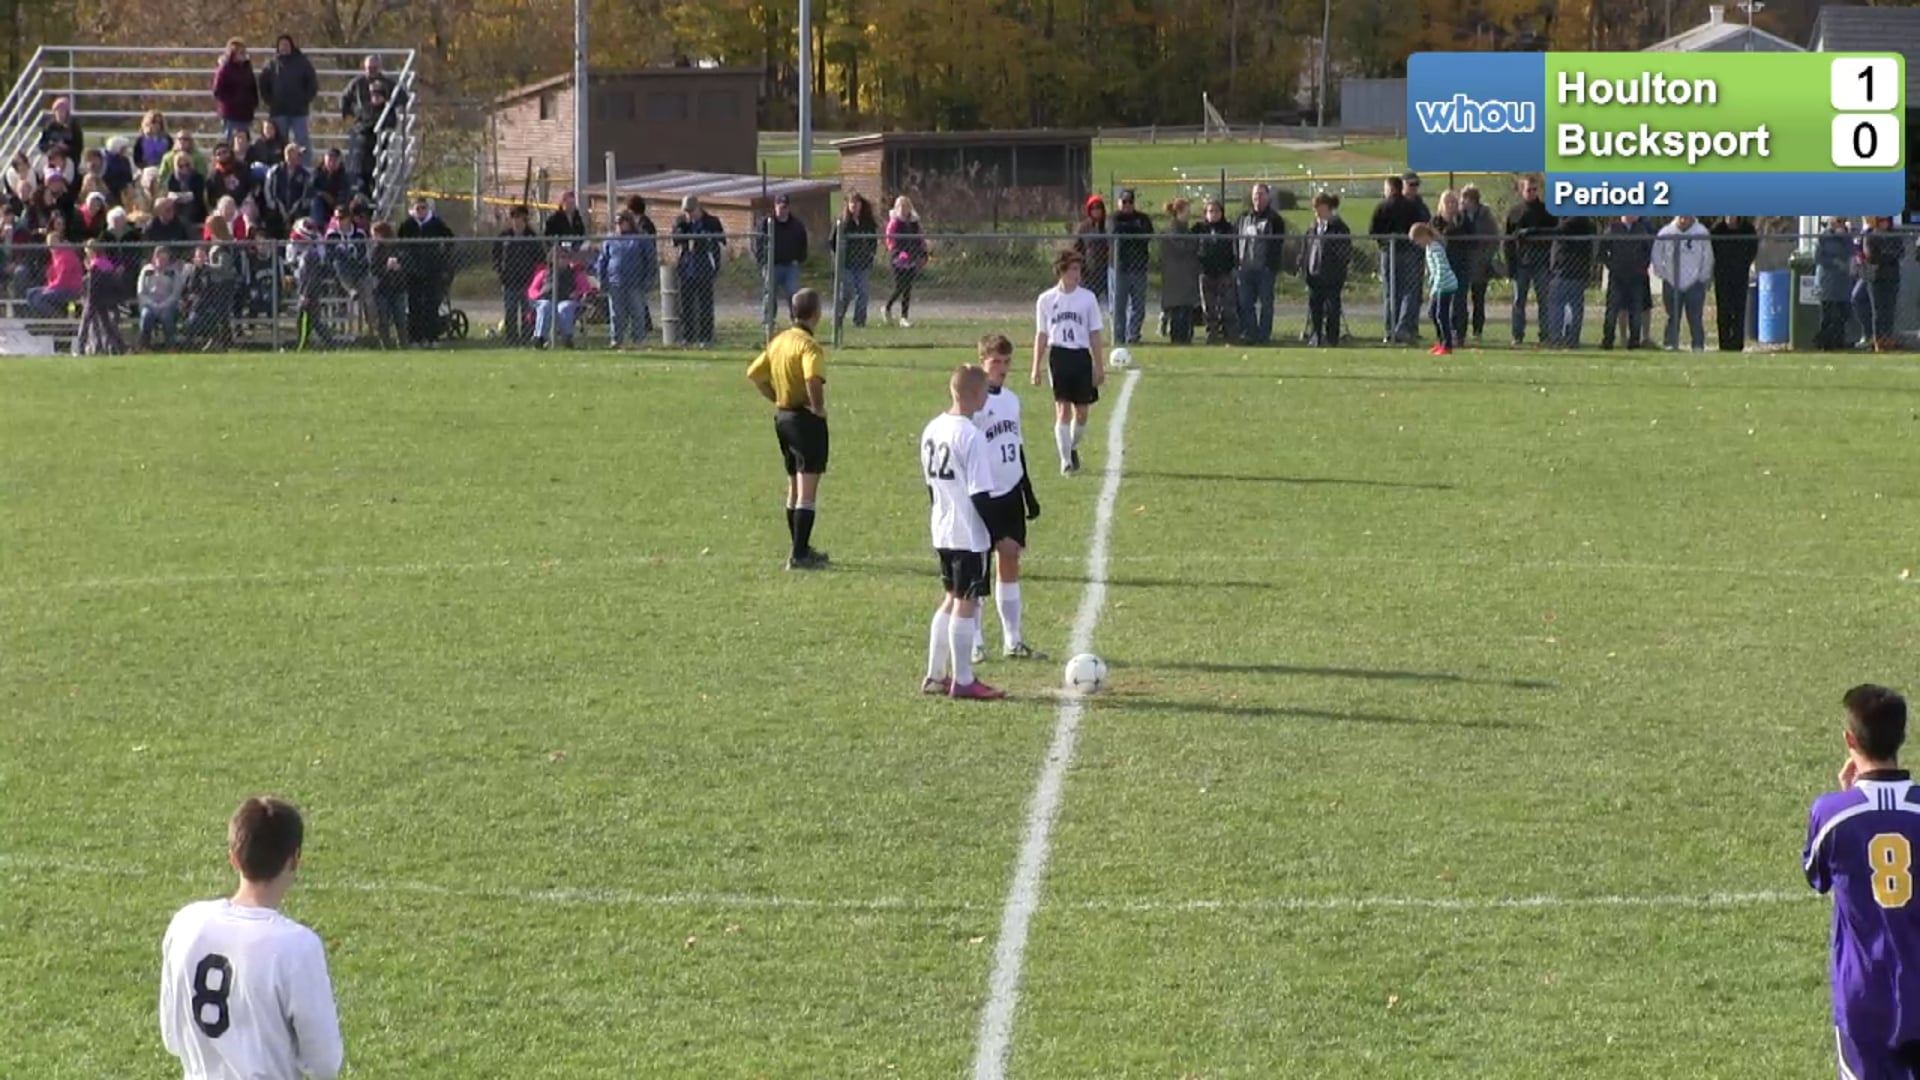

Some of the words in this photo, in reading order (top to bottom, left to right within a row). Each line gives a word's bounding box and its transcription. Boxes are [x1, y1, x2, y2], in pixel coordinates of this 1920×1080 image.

[1062, 328, 1075, 342] 14
[924, 438, 955, 480] 22
[1000, 443, 1016, 463] 13
[1868, 832, 1912, 908] 8
[192, 953, 233, 1038] 8
